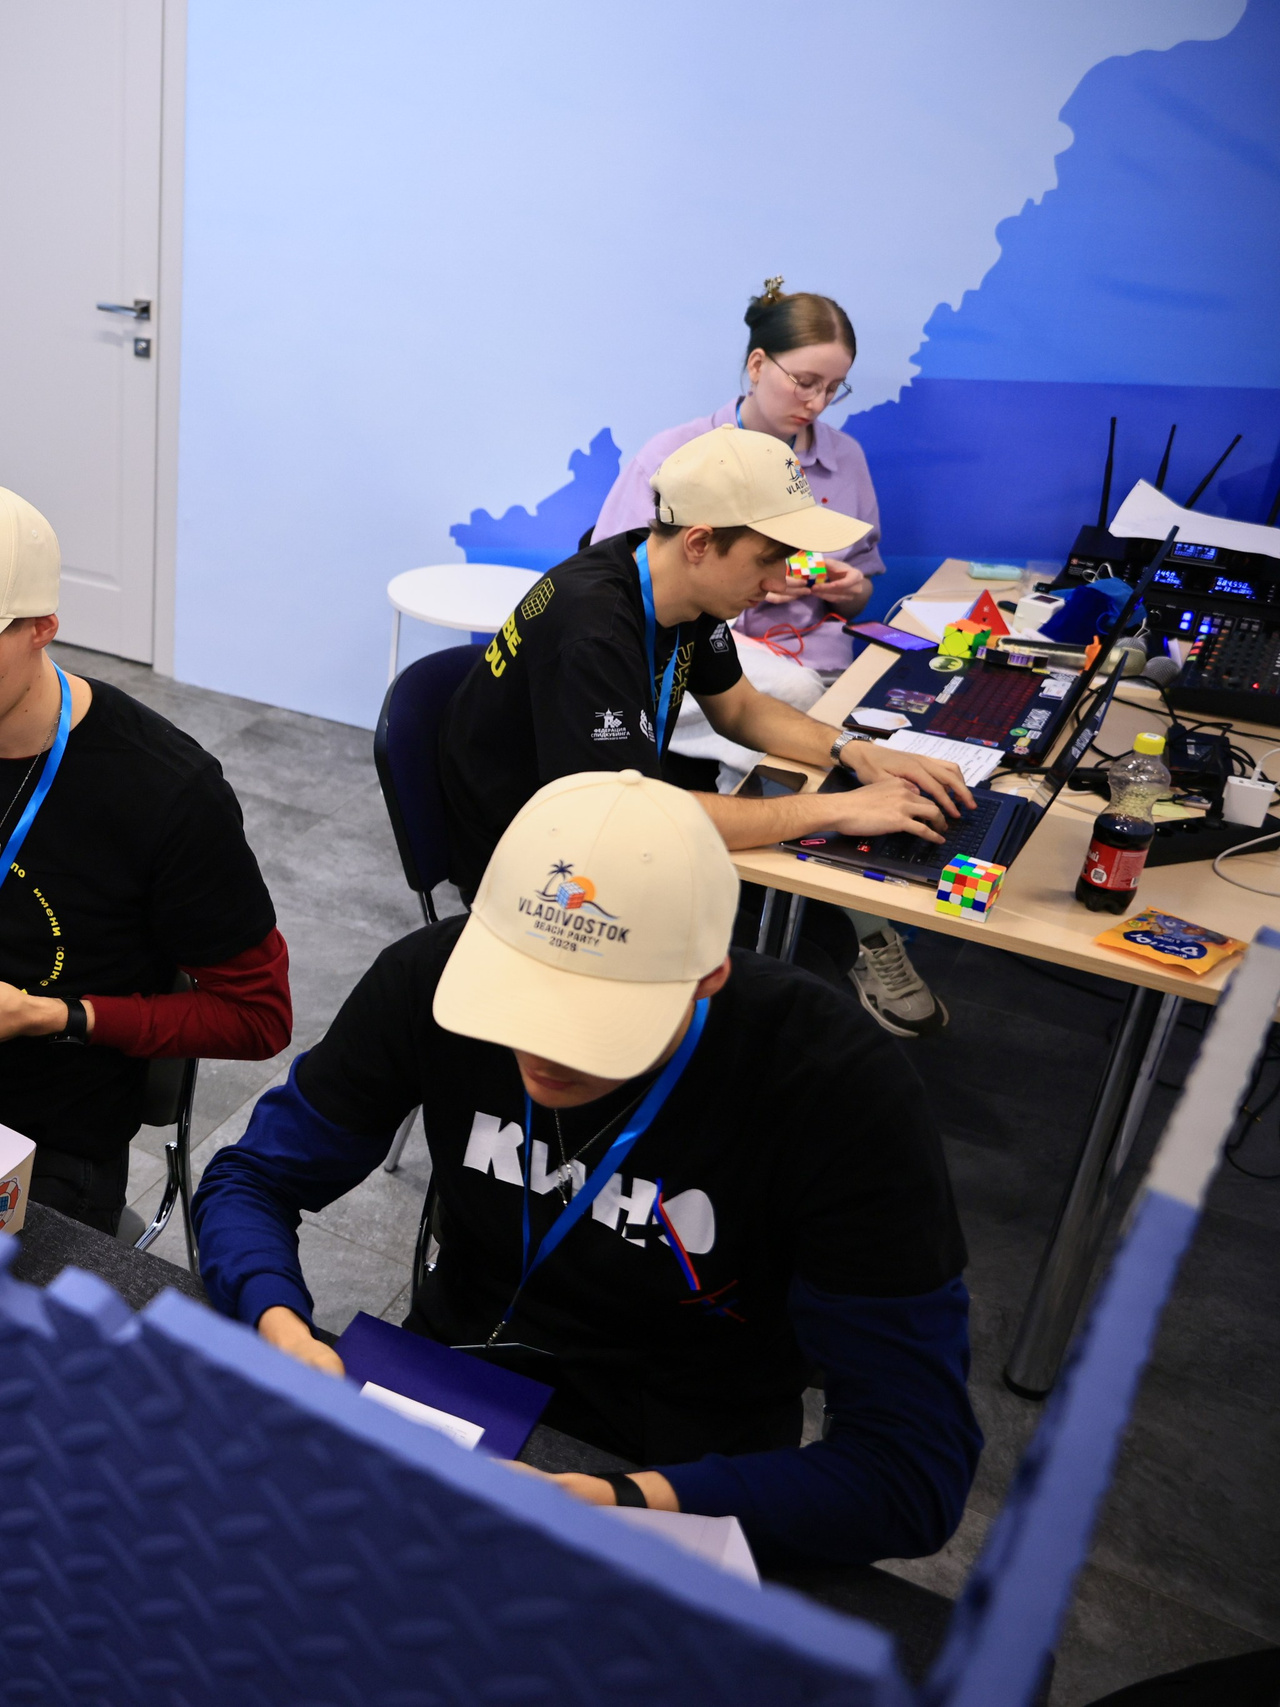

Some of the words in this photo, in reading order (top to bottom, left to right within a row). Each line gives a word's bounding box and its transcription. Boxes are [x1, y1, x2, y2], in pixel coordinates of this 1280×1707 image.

[484, 638, 507, 678] OU
[10, 862, 26, 878] по
[33, 887, 61, 937] имени
[518, 897, 630, 944] VLADIVOSTOK
[533, 920, 564, 936] BEACH
[567, 931, 600, 947] PARTY
